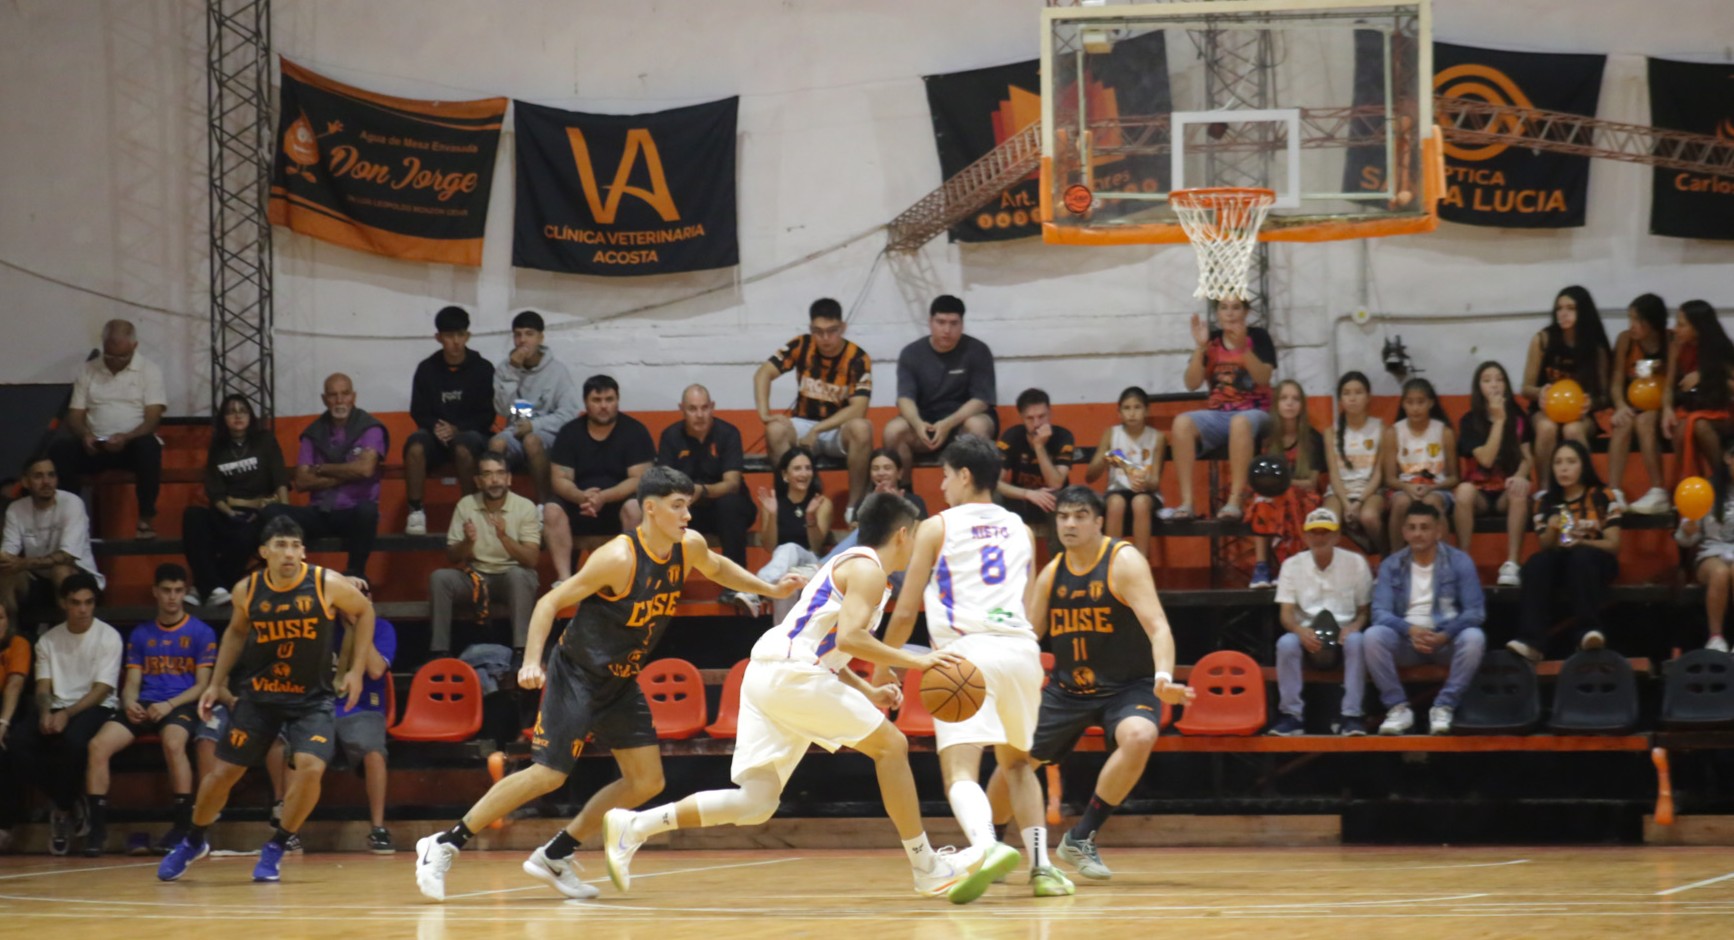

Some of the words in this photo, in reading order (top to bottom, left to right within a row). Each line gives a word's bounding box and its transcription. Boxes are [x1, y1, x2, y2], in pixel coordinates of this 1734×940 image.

[361, 131, 386, 144] Agua
[388, 136, 402, 146] de
[329, 145, 391, 184] Don
[390, 156, 478, 202] Jorge
[1444, 166, 1506, 187] PTICA
[1001, 190, 1036, 208] Art.
[1472, 188, 1568, 214] LUCIA
[544, 224, 607, 245] CLÍNICA
[606, 223, 706, 246] VETERINARIA
[592, 250, 659, 265] ACOSTA
[981, 544, 1006, 585] 8
[1050, 607, 1114, 637] CUSE
[1072, 637, 1089, 662] 11
